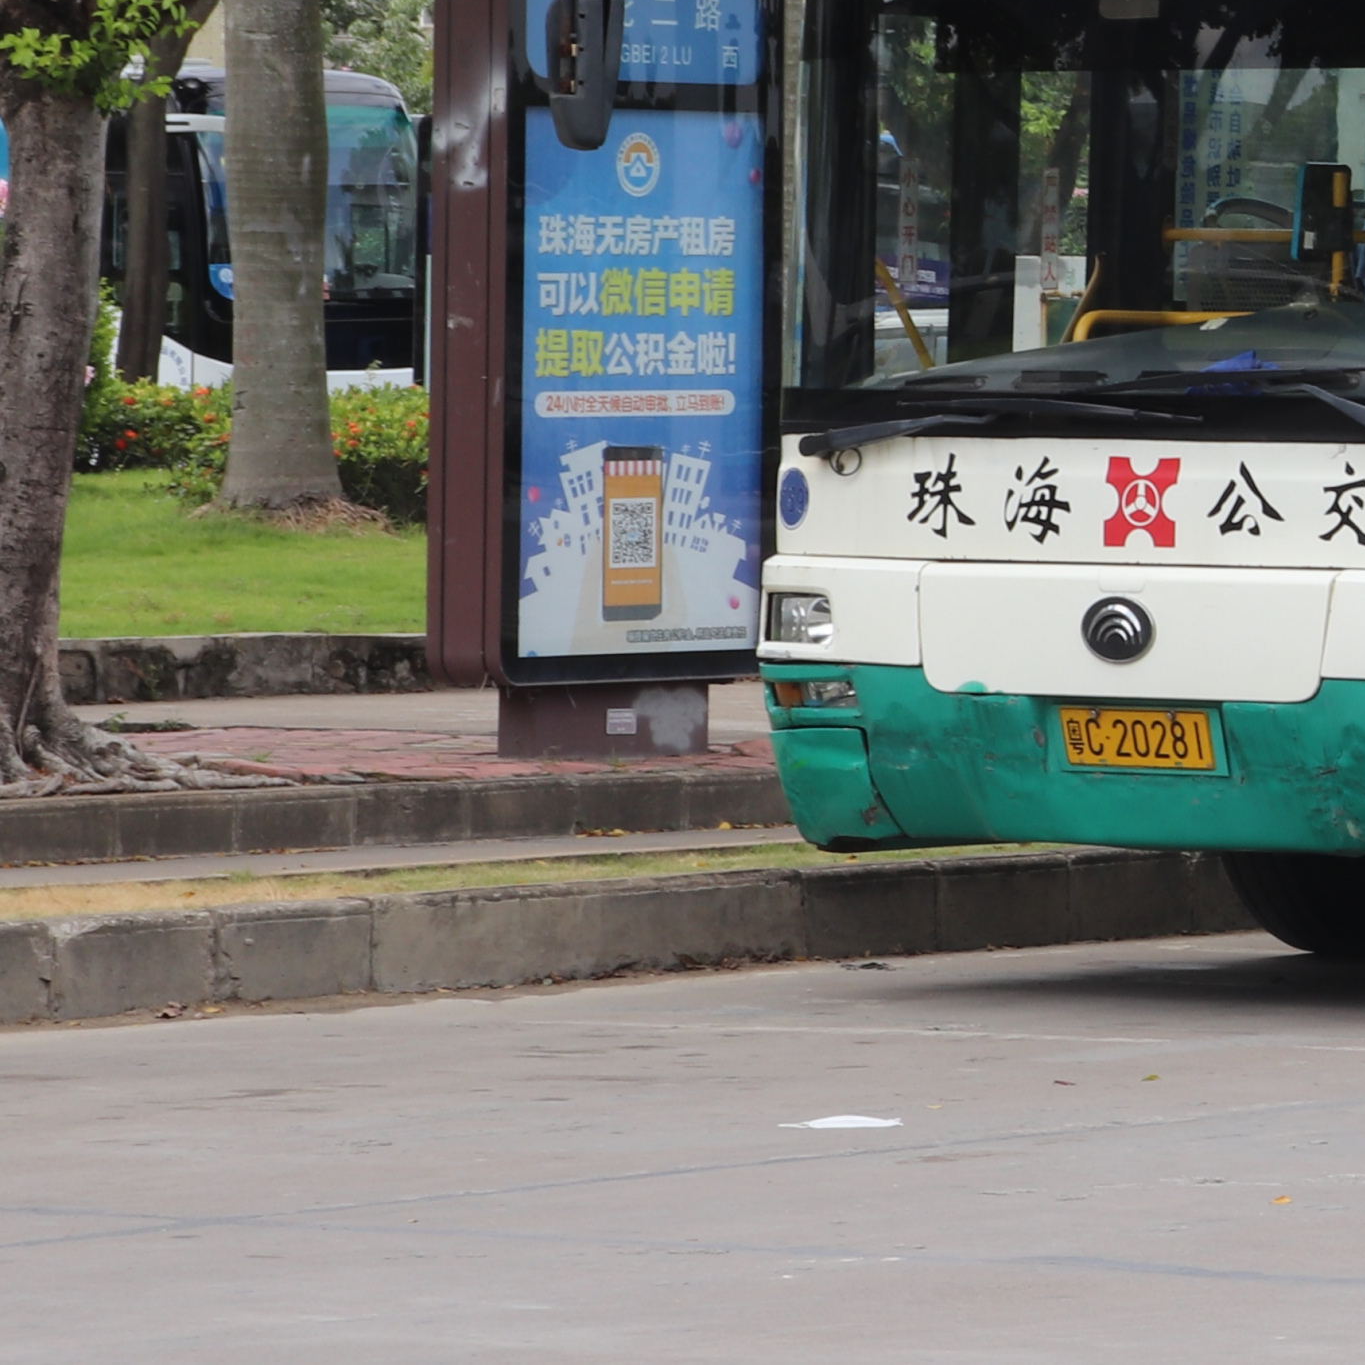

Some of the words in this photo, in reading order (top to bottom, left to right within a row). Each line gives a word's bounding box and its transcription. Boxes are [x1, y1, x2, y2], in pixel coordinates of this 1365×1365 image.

[660, 46, 668, 64] 2
[673, 46, 692, 65] LU
[722, 45, 739, 69] 西
[538, 213, 736, 256] 珠海无房产租房
[901, 167, 917, 275] 小心开门
[1043, 175, 1059, 282] 严禁站人
[537, 266, 735, 317] 可以微信申请
